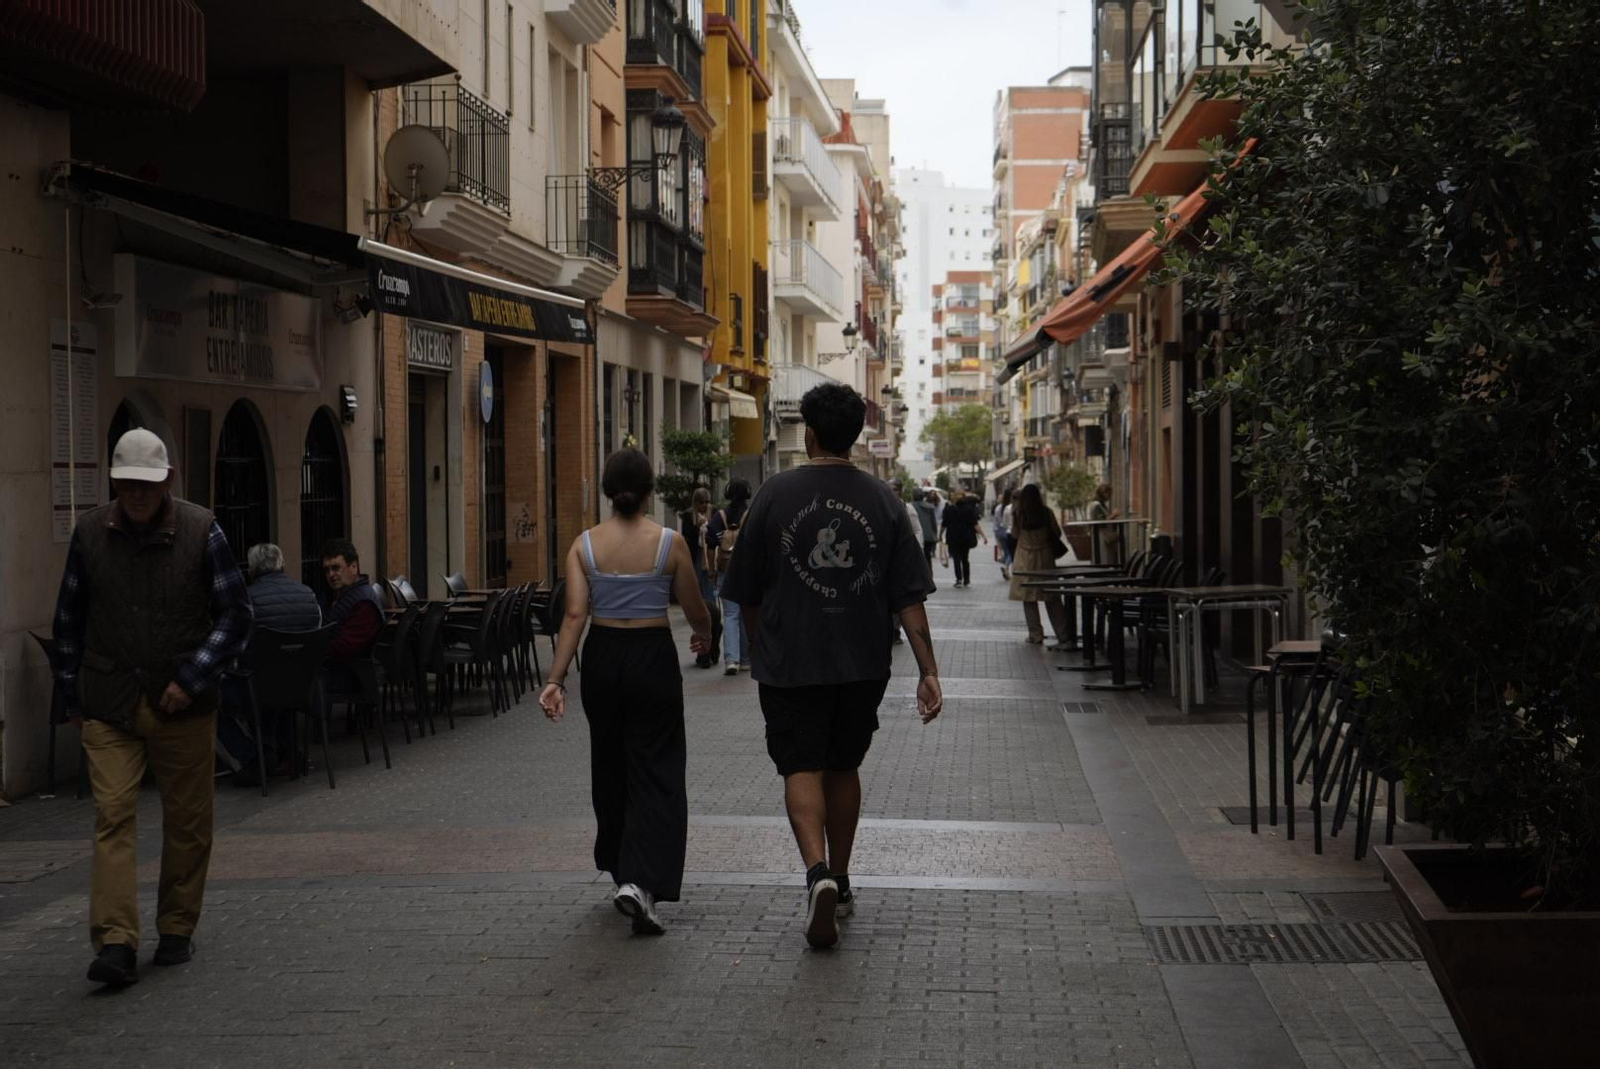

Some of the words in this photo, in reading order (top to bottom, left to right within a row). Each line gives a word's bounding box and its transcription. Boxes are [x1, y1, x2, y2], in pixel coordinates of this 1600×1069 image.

[208, 290, 228, 329] BAR
[406, 324, 452, 366] RASTEROS
[826, 499, 877, 549] Conquest
[790, 556, 838, 599] Chopper
